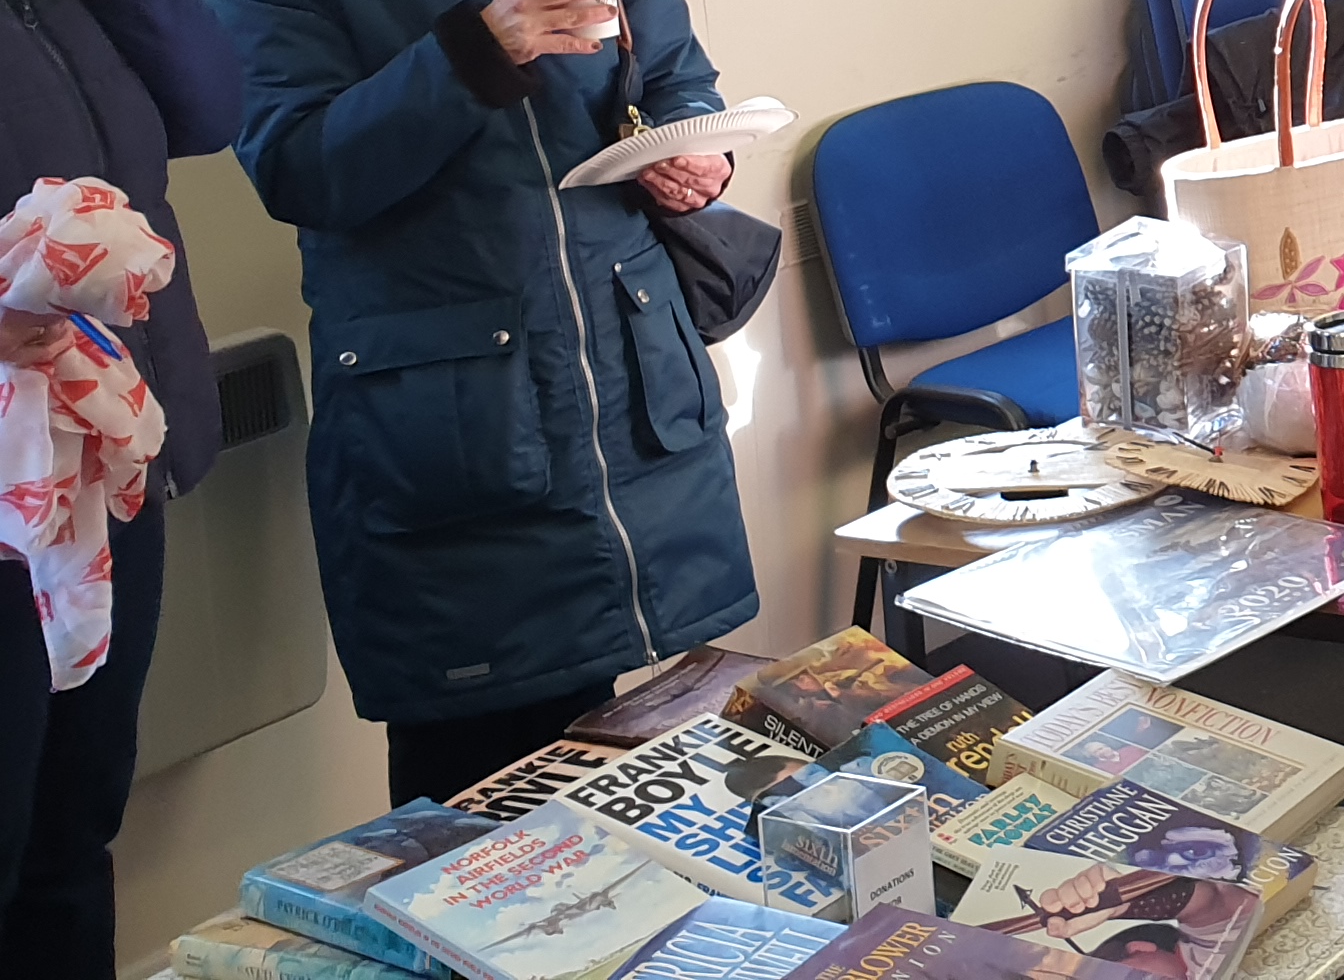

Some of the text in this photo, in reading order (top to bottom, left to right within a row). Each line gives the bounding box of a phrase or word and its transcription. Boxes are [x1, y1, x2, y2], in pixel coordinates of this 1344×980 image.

[764, 714, 824, 759] SILENT
[896, 683, 988, 735] THE TREE OF HANDS
[909, 691, 1003, 747] A DEMON IN MY VIEW
[1020, 674, 1144, 752] TODAY'S BEST
[1143, 685, 1281, 747] NONFICTION
[564, 718, 730, 808] FRANKIE
[946, 731, 980, 753] ruth
[451, 745, 576, 813] RANKIE
[595, 730, 773, 826] BOYLE
[635, 794, 717, 843] MY
[1045, 780, 1139, 845] CHRISTIANE
[1068, 793, 1180, 863] HEGGAN
[440, 829, 532, 875] NORFOLK
[443, 834, 584, 906] IN THE SECOND
[456, 838, 547, 886] AIRFIELDS
[469, 849, 590, 909] WORLD WAR
[869, 867, 915, 902] DONATIONS
[838, 921, 939, 980] LOWER
